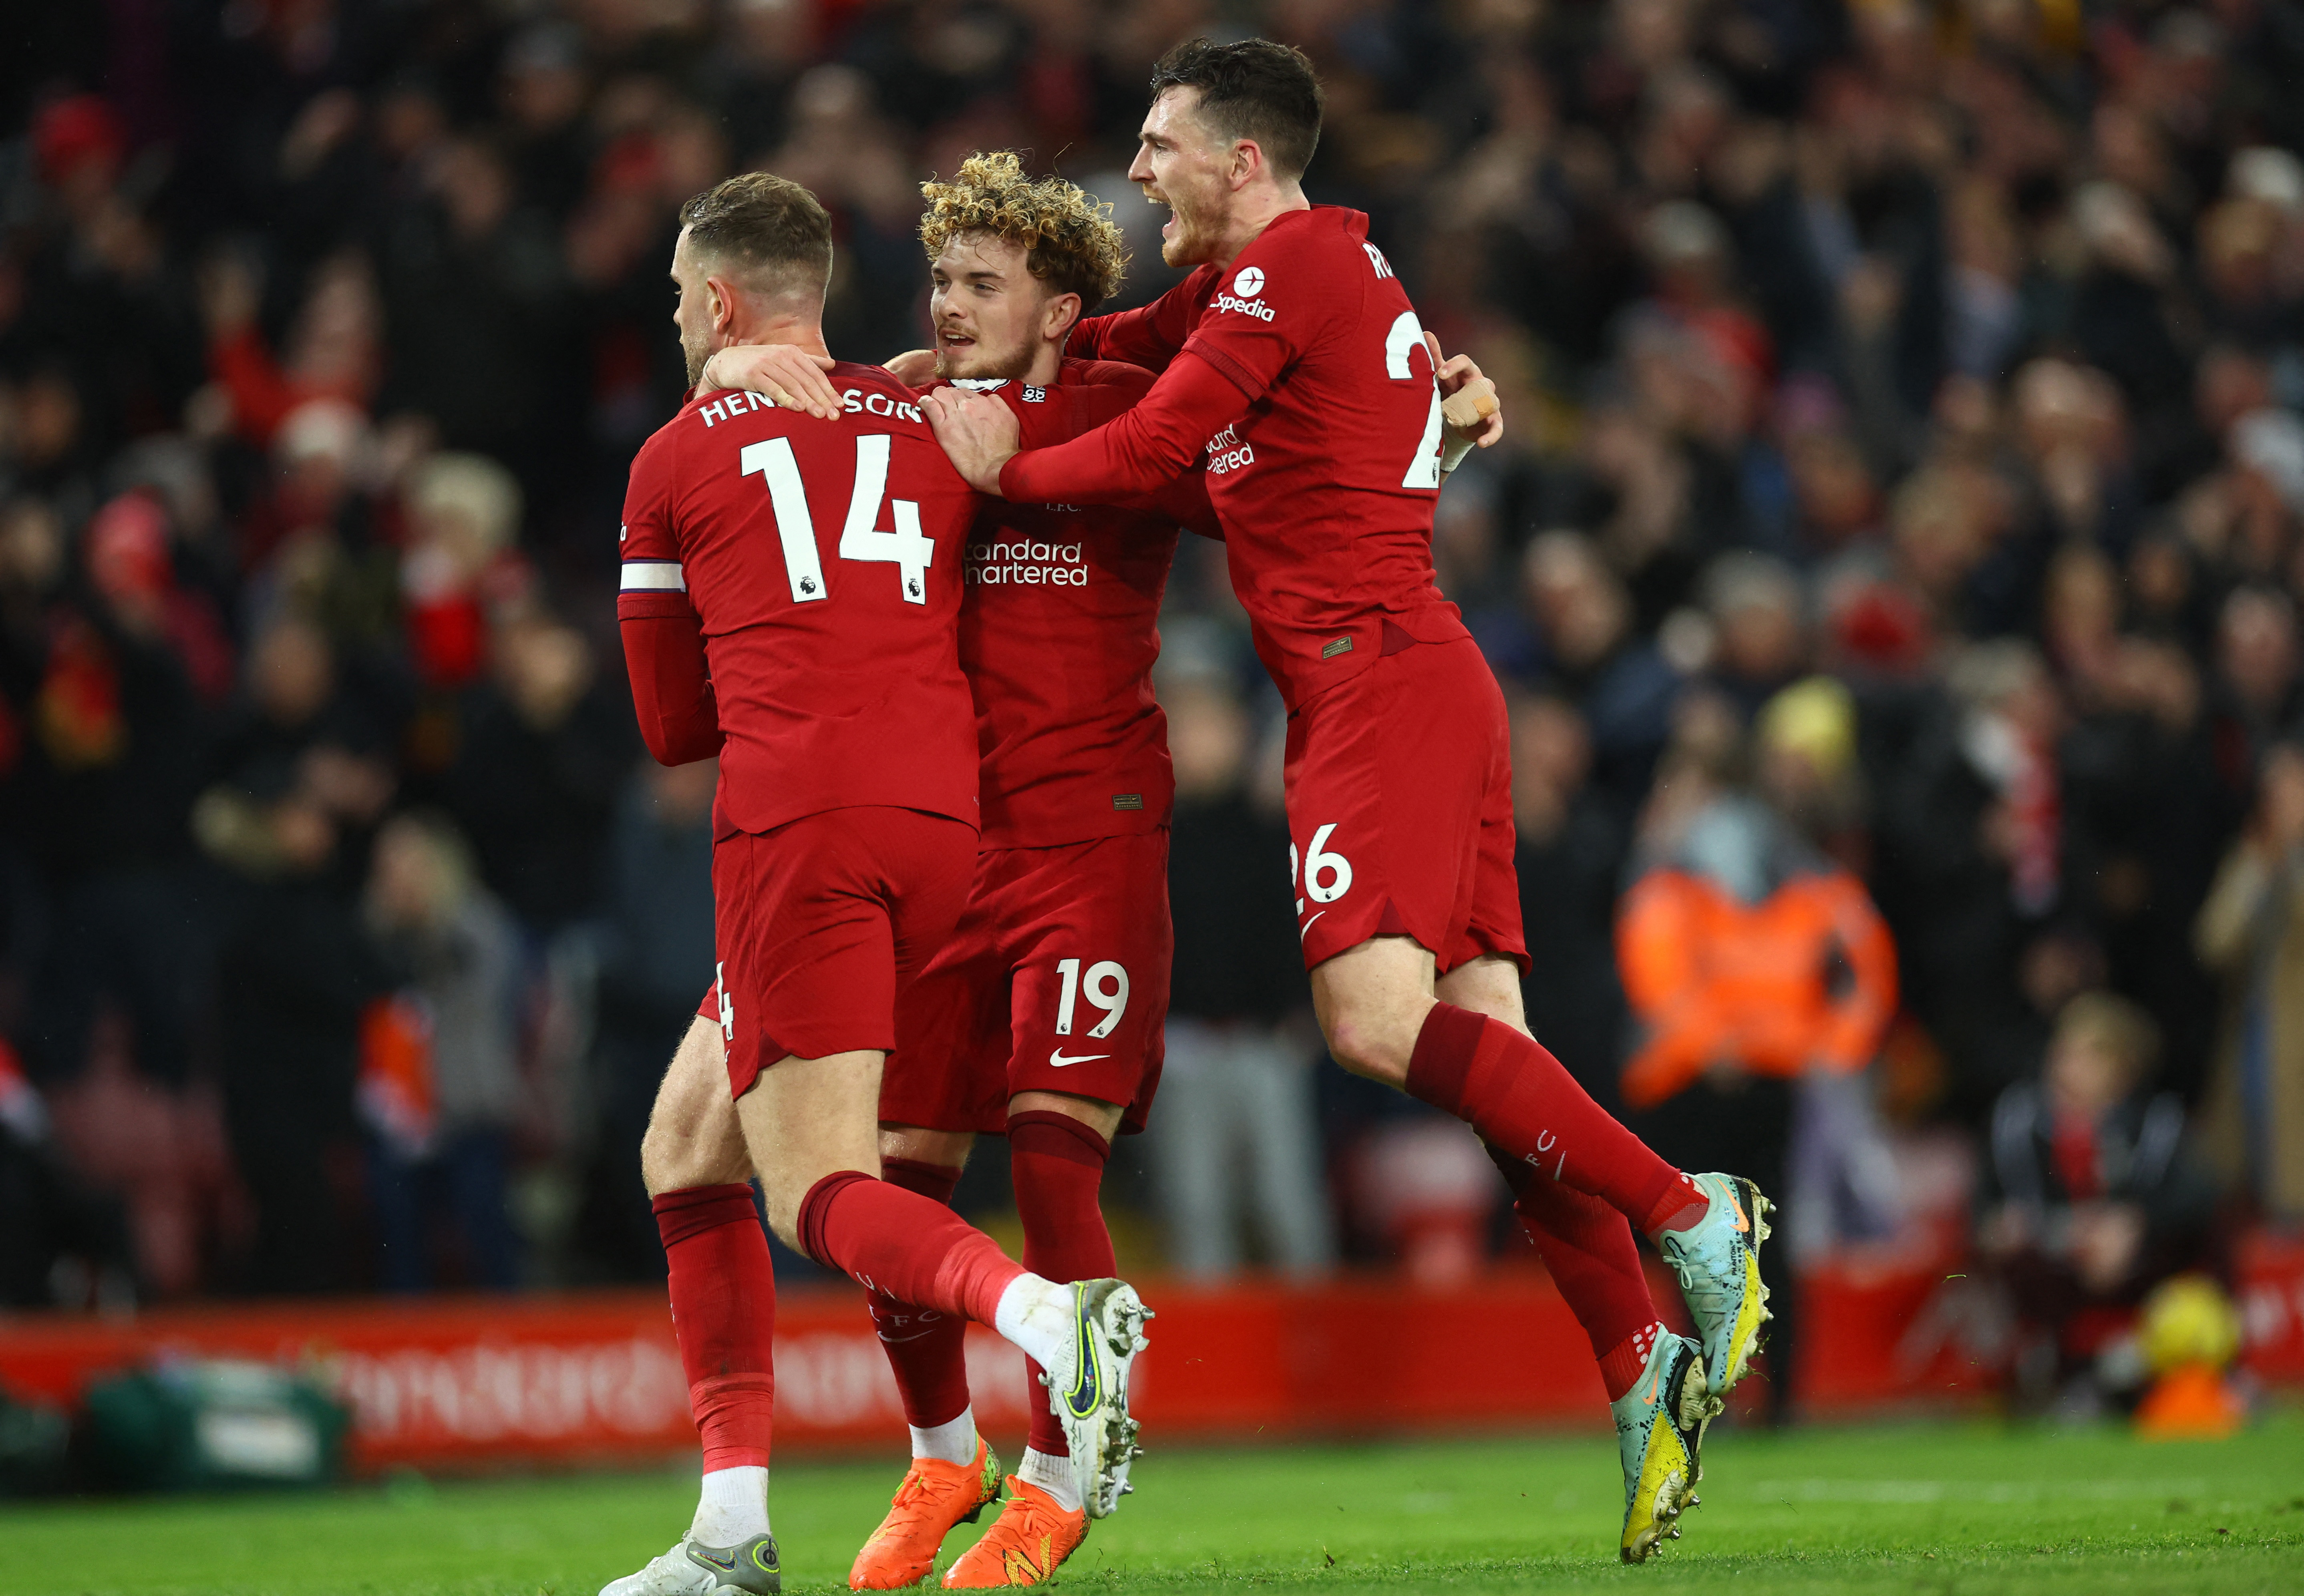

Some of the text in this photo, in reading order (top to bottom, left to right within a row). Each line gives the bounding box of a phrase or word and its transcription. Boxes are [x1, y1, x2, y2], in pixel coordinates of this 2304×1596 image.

[698, 388, 922, 428] HENSON
[740, 434, 935, 605] 14
[1056, 958, 1129, 1039] 19
